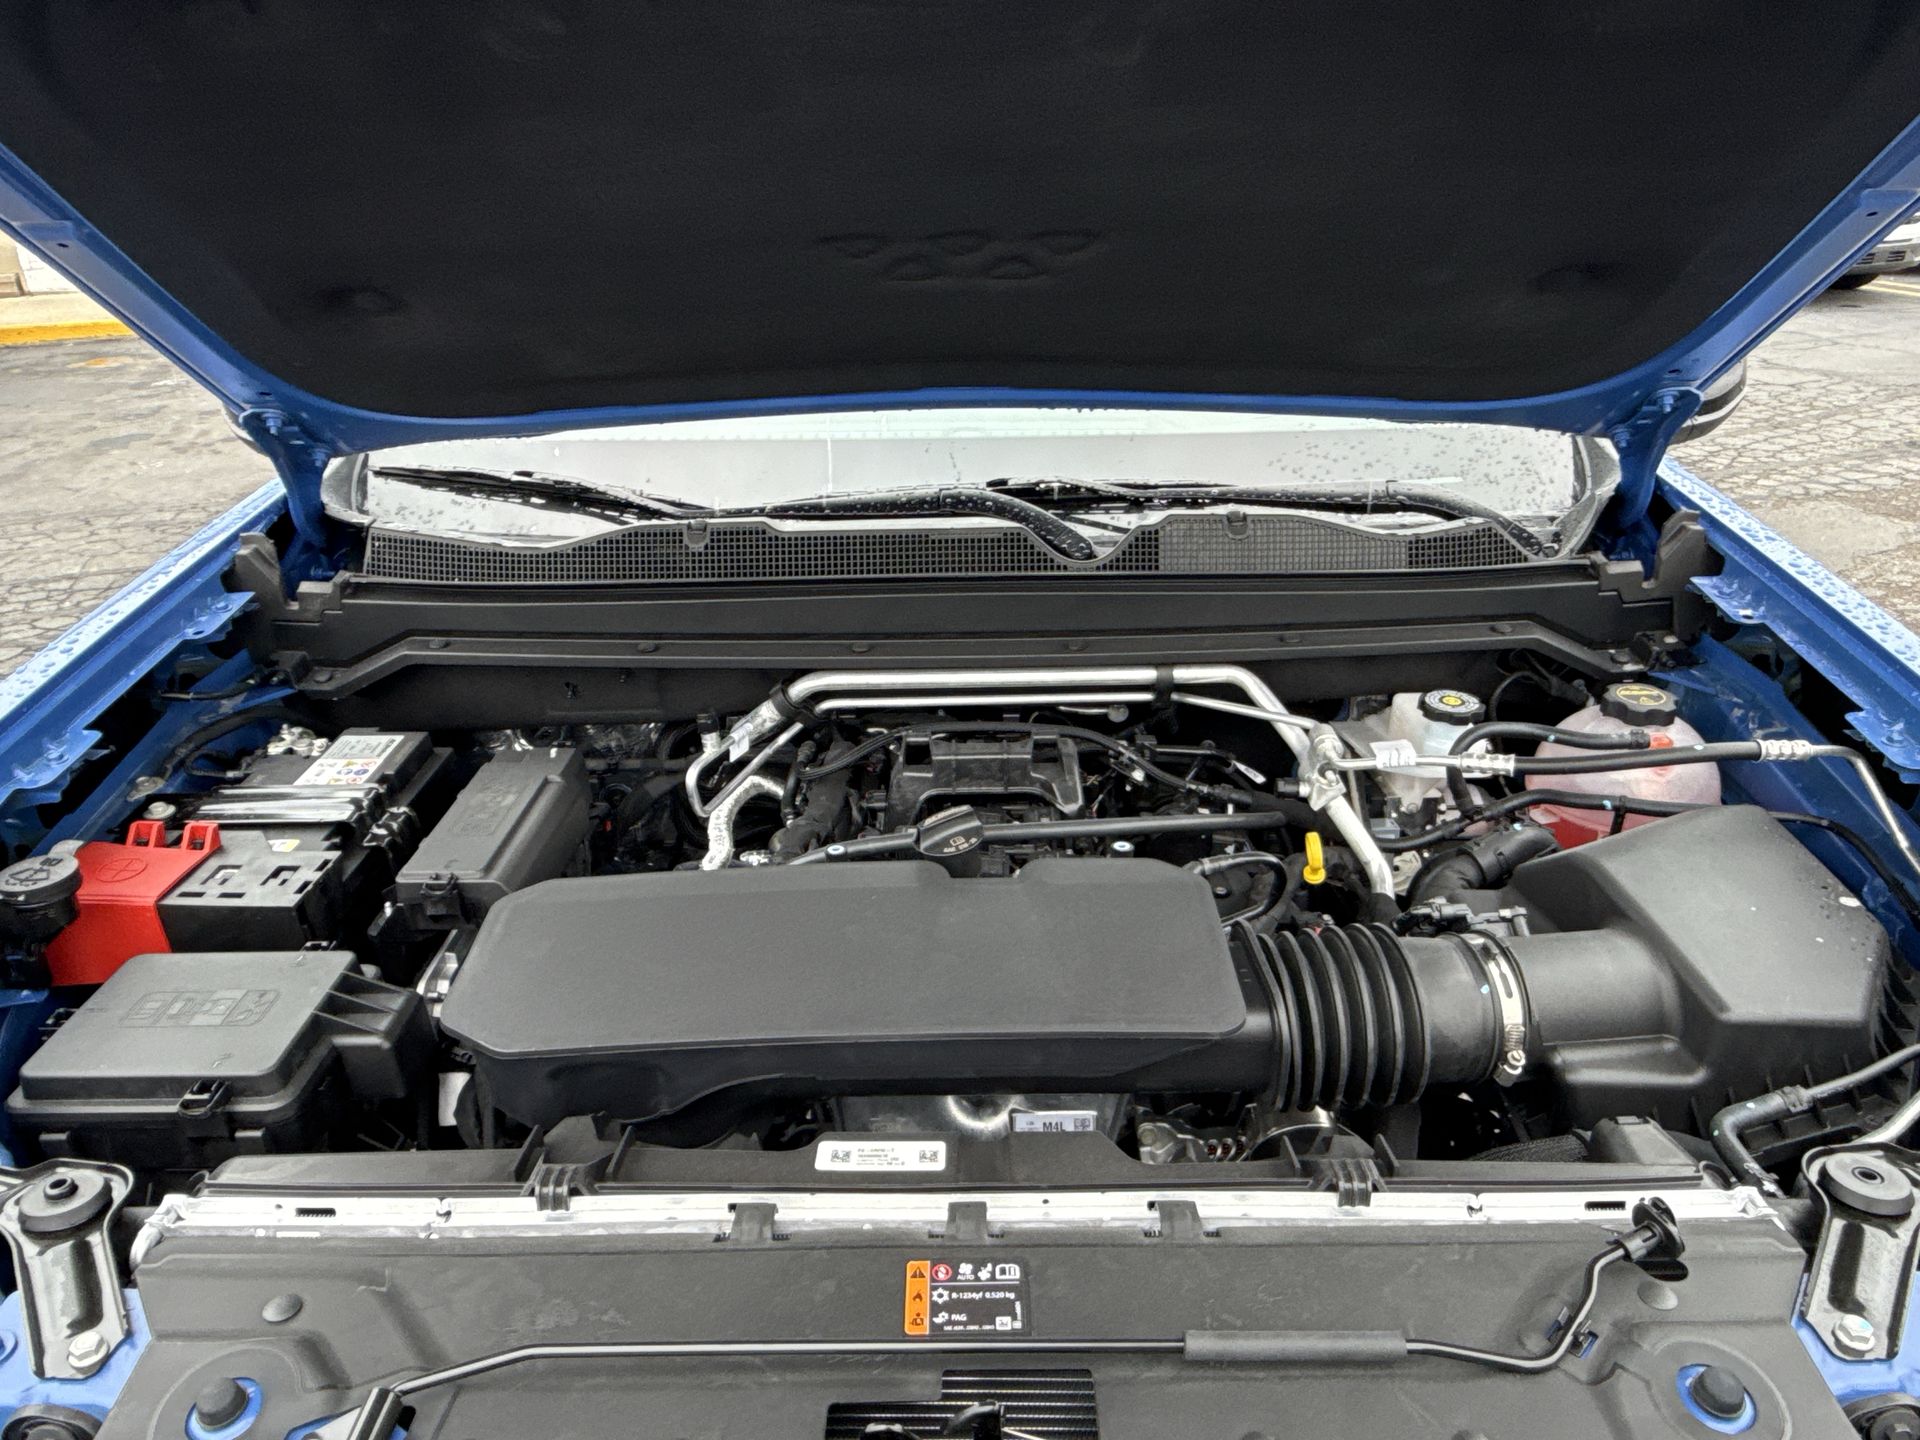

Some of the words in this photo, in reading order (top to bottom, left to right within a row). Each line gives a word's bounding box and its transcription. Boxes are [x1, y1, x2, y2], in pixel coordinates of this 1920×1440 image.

[1042, 1121, 1066, 1132] M4L
[1005, 1291, 1015, 1299] kg
[951, 1313, 967, 1321] PAG
